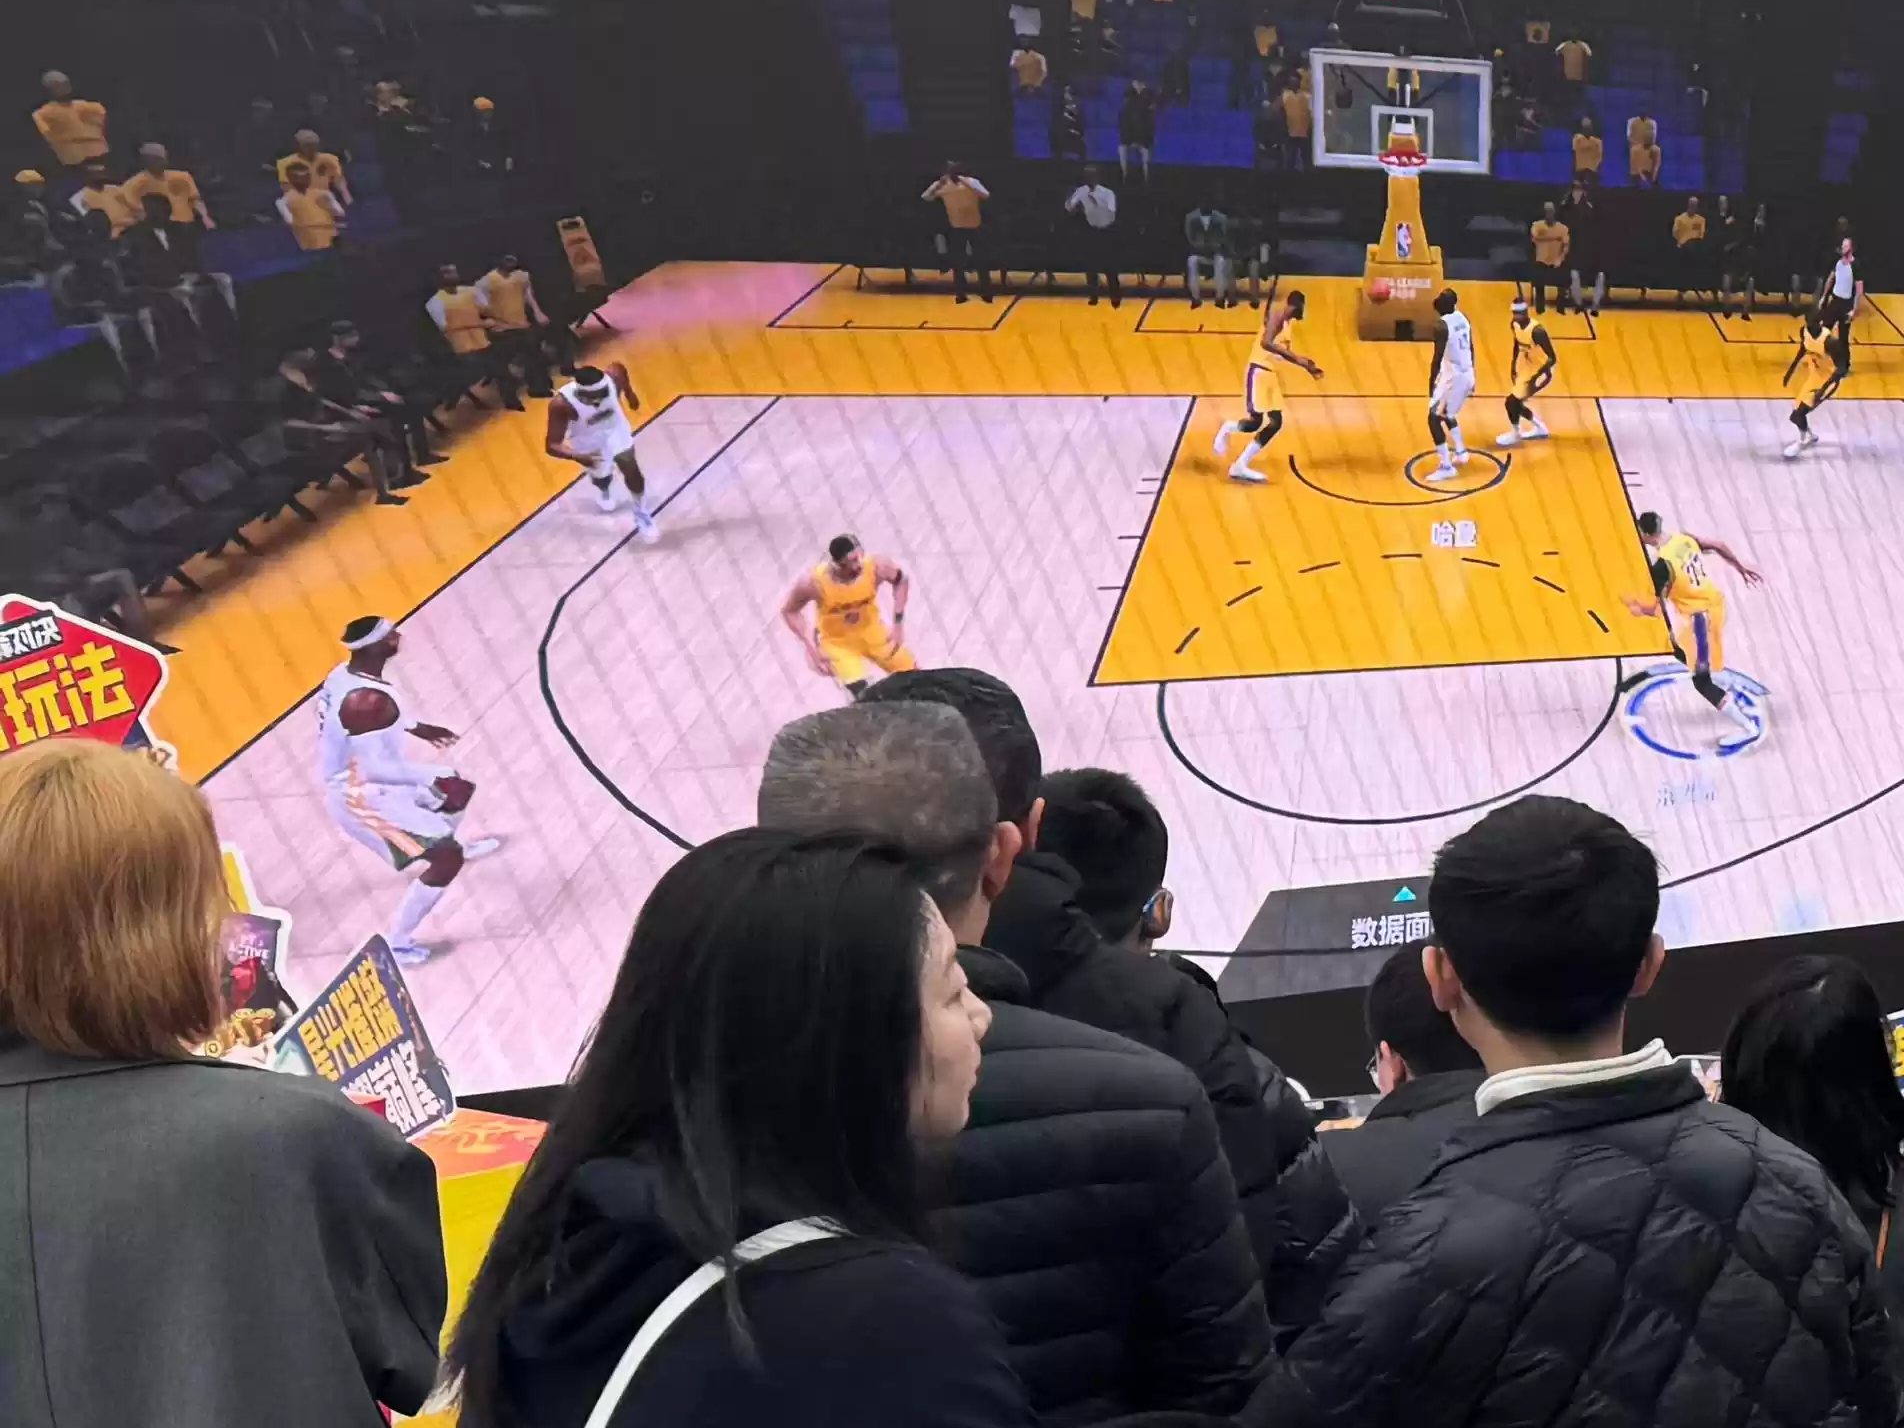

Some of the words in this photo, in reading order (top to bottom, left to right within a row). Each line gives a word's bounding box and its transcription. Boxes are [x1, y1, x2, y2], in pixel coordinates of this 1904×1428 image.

[0, 641, 135, 753] 玩法
[1351, 910, 1436, 950] 数据面
